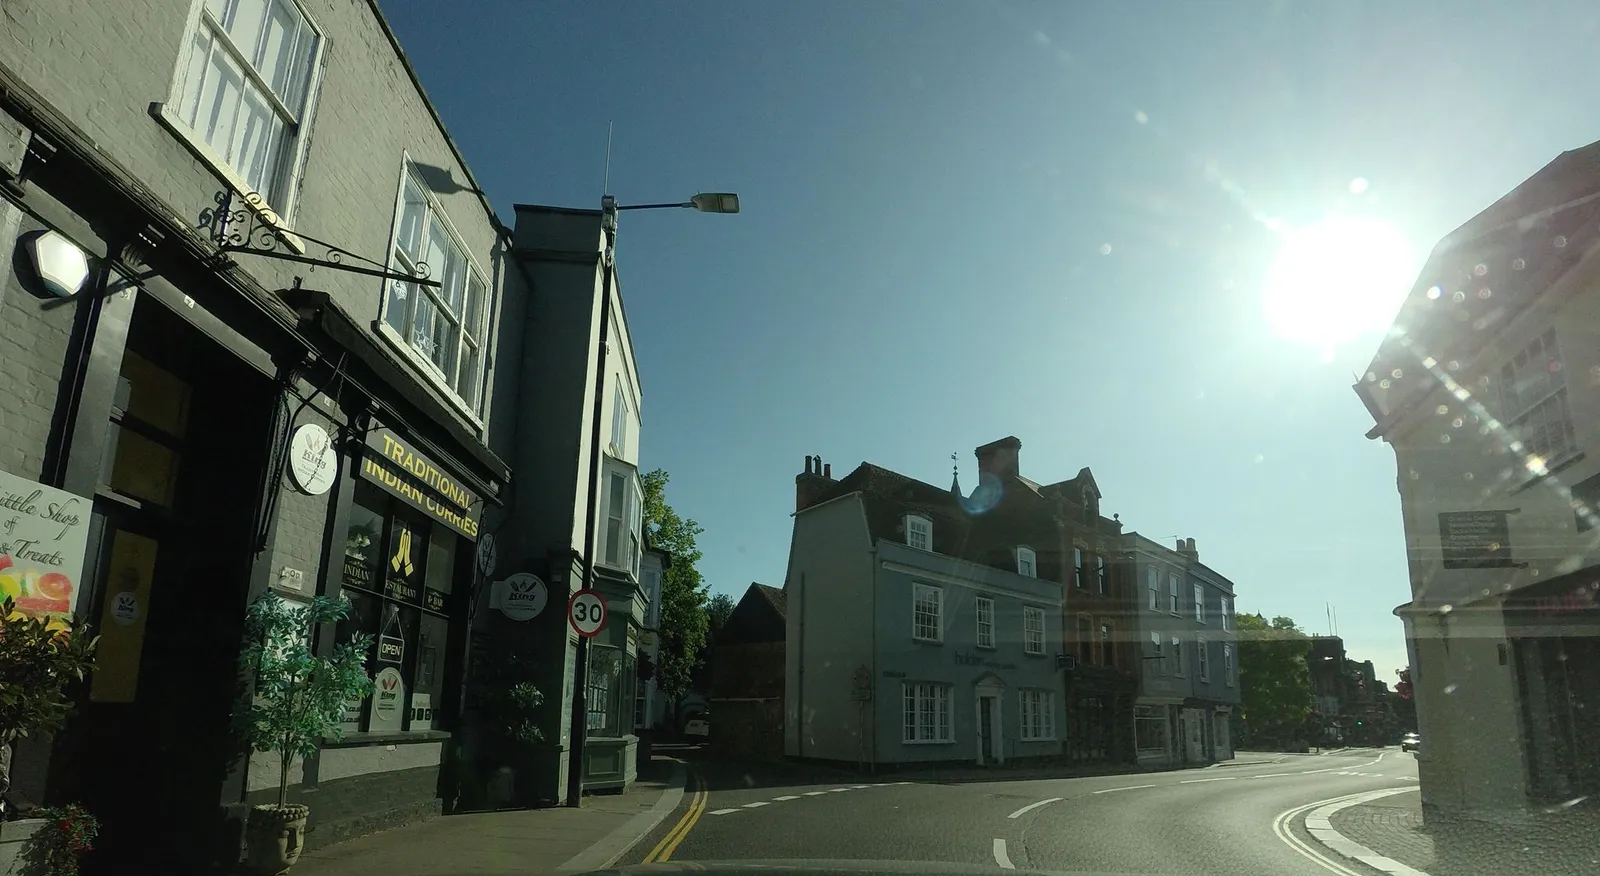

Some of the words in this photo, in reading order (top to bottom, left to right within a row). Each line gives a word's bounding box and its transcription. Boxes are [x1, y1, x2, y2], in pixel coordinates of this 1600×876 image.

[383, 433, 472, 512] TRADITIONAL
[365, 459, 424, 505] INDIAN
[426, 496, 479, 537] CURRIES
[0, 489, 43, 515] ittle
[40, 498, 80, 541] Shop
[4, 516, 20, 536] of
[13, 539, 65, 566] Treats
[344, 563, 370, 581] INDIAN
[385, 579, 417, 599] ESTAURANT
[509, 592, 536, 602] King
[574, 602, 602, 624] 30
[382, 643, 402, 656] OPEN
